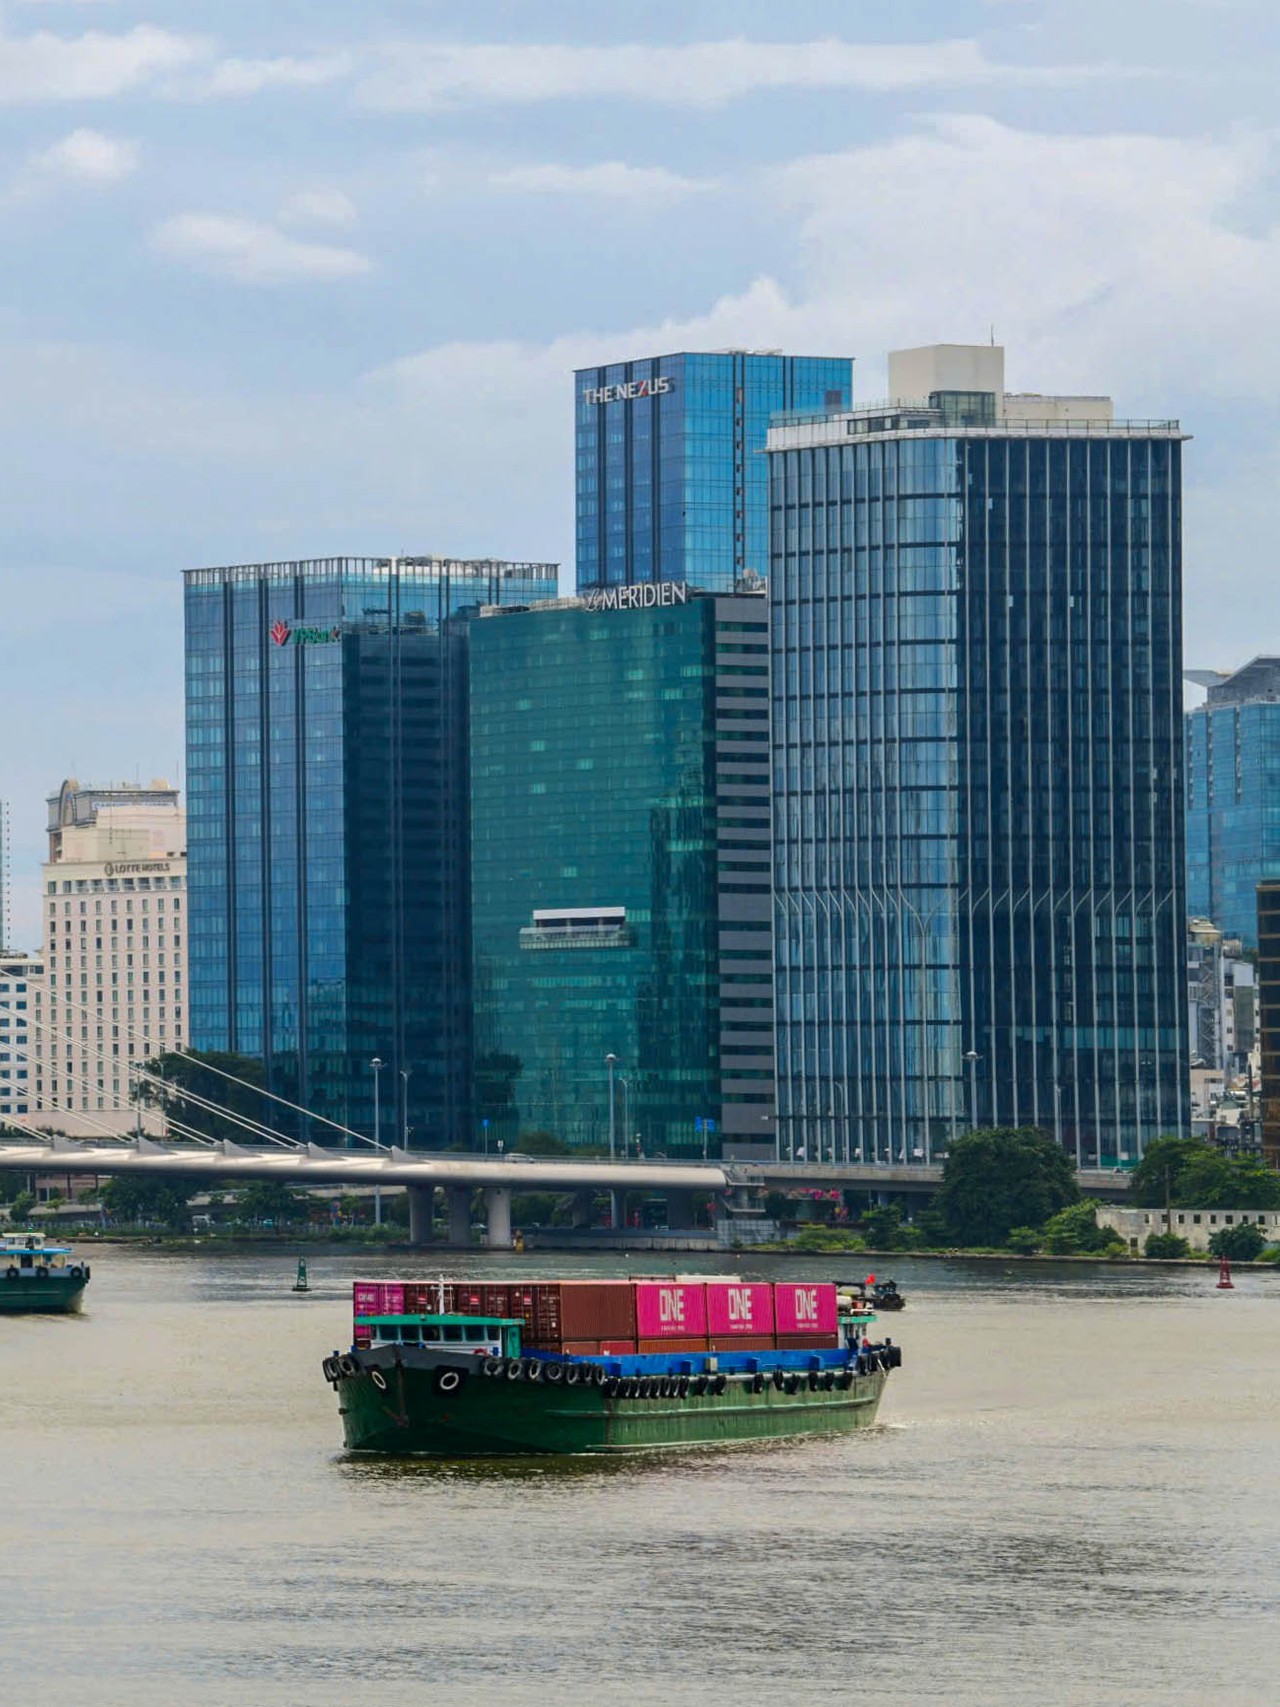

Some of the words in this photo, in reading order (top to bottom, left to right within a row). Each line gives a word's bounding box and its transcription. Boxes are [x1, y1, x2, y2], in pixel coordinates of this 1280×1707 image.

[584, 386, 614, 405] THE
[617, 377, 671, 400] NEXUS
[602, 581, 686, 610] MERIDIEN
[115, 864, 141, 874] LOTTE
[142, 863, 170, 872] HOTELS
[660, 1289, 685, 1321] ONE
[728, 1288, 753, 1320] ONE
[795, 1288, 818, 1320] ONE
